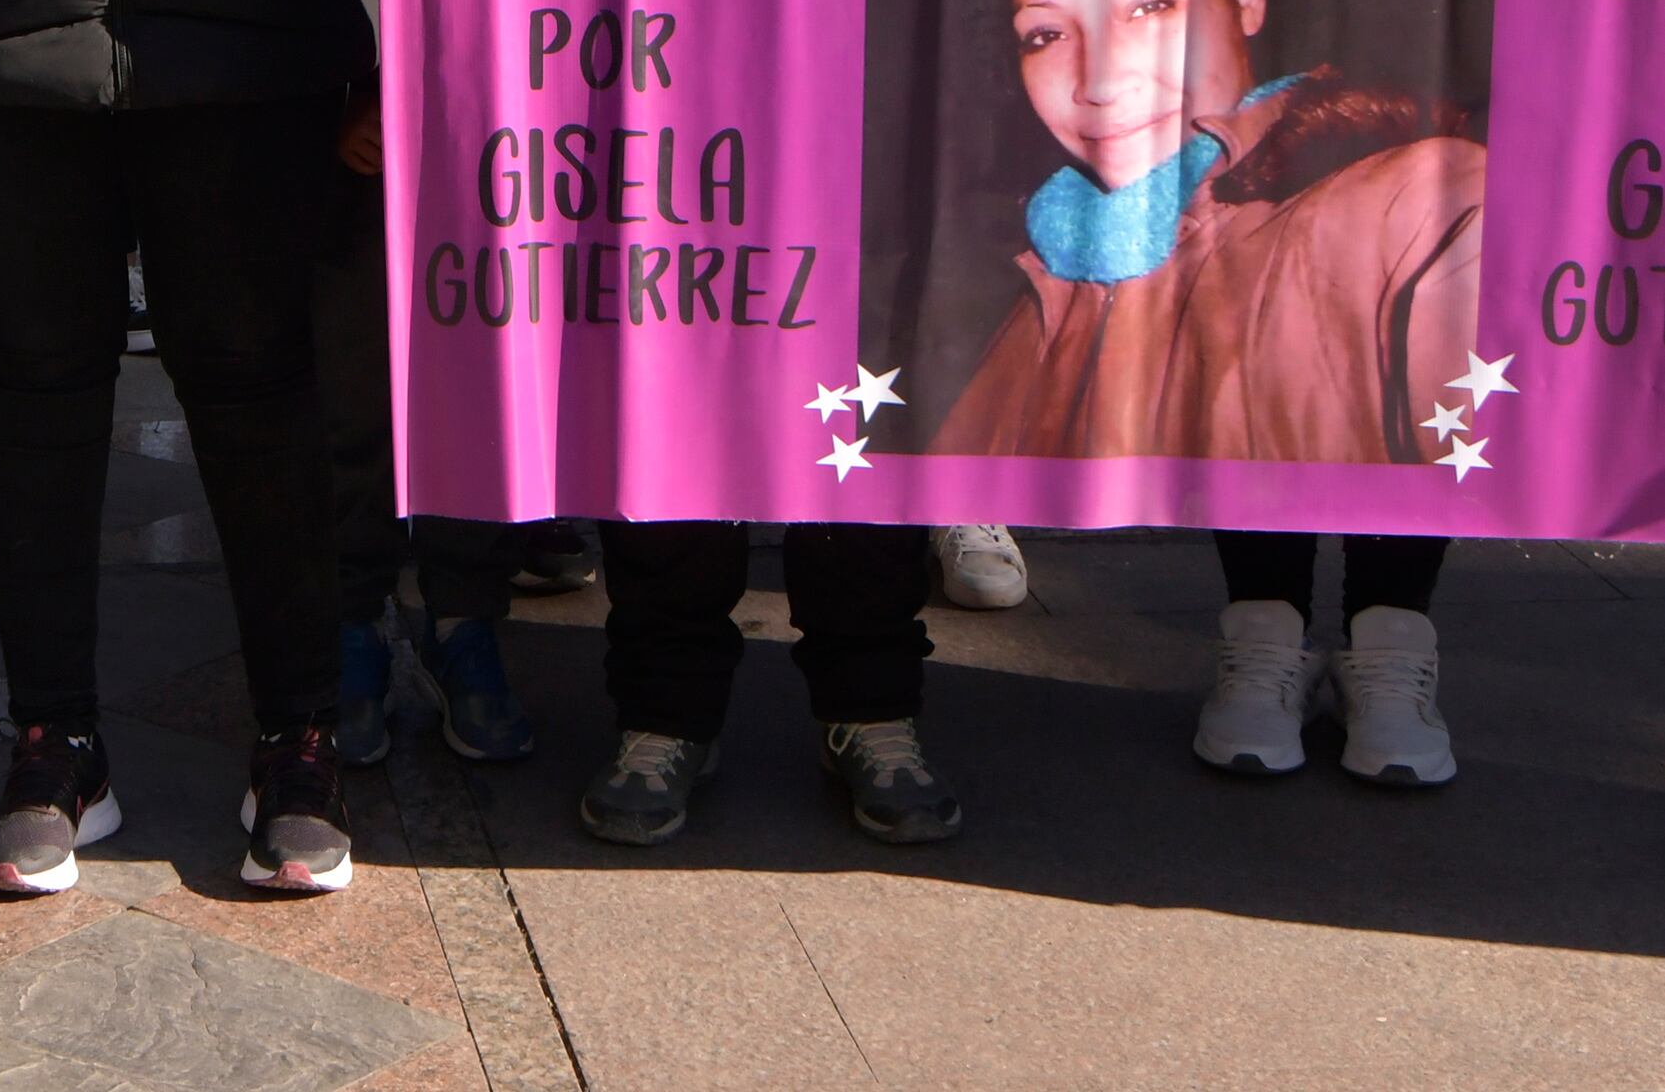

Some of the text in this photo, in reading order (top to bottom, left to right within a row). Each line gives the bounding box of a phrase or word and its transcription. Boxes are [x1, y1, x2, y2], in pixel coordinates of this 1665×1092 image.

[528, 7, 677, 93] POR
[477, 123, 746, 228] GISELA
[424, 240, 818, 330] GUTIERREZ
